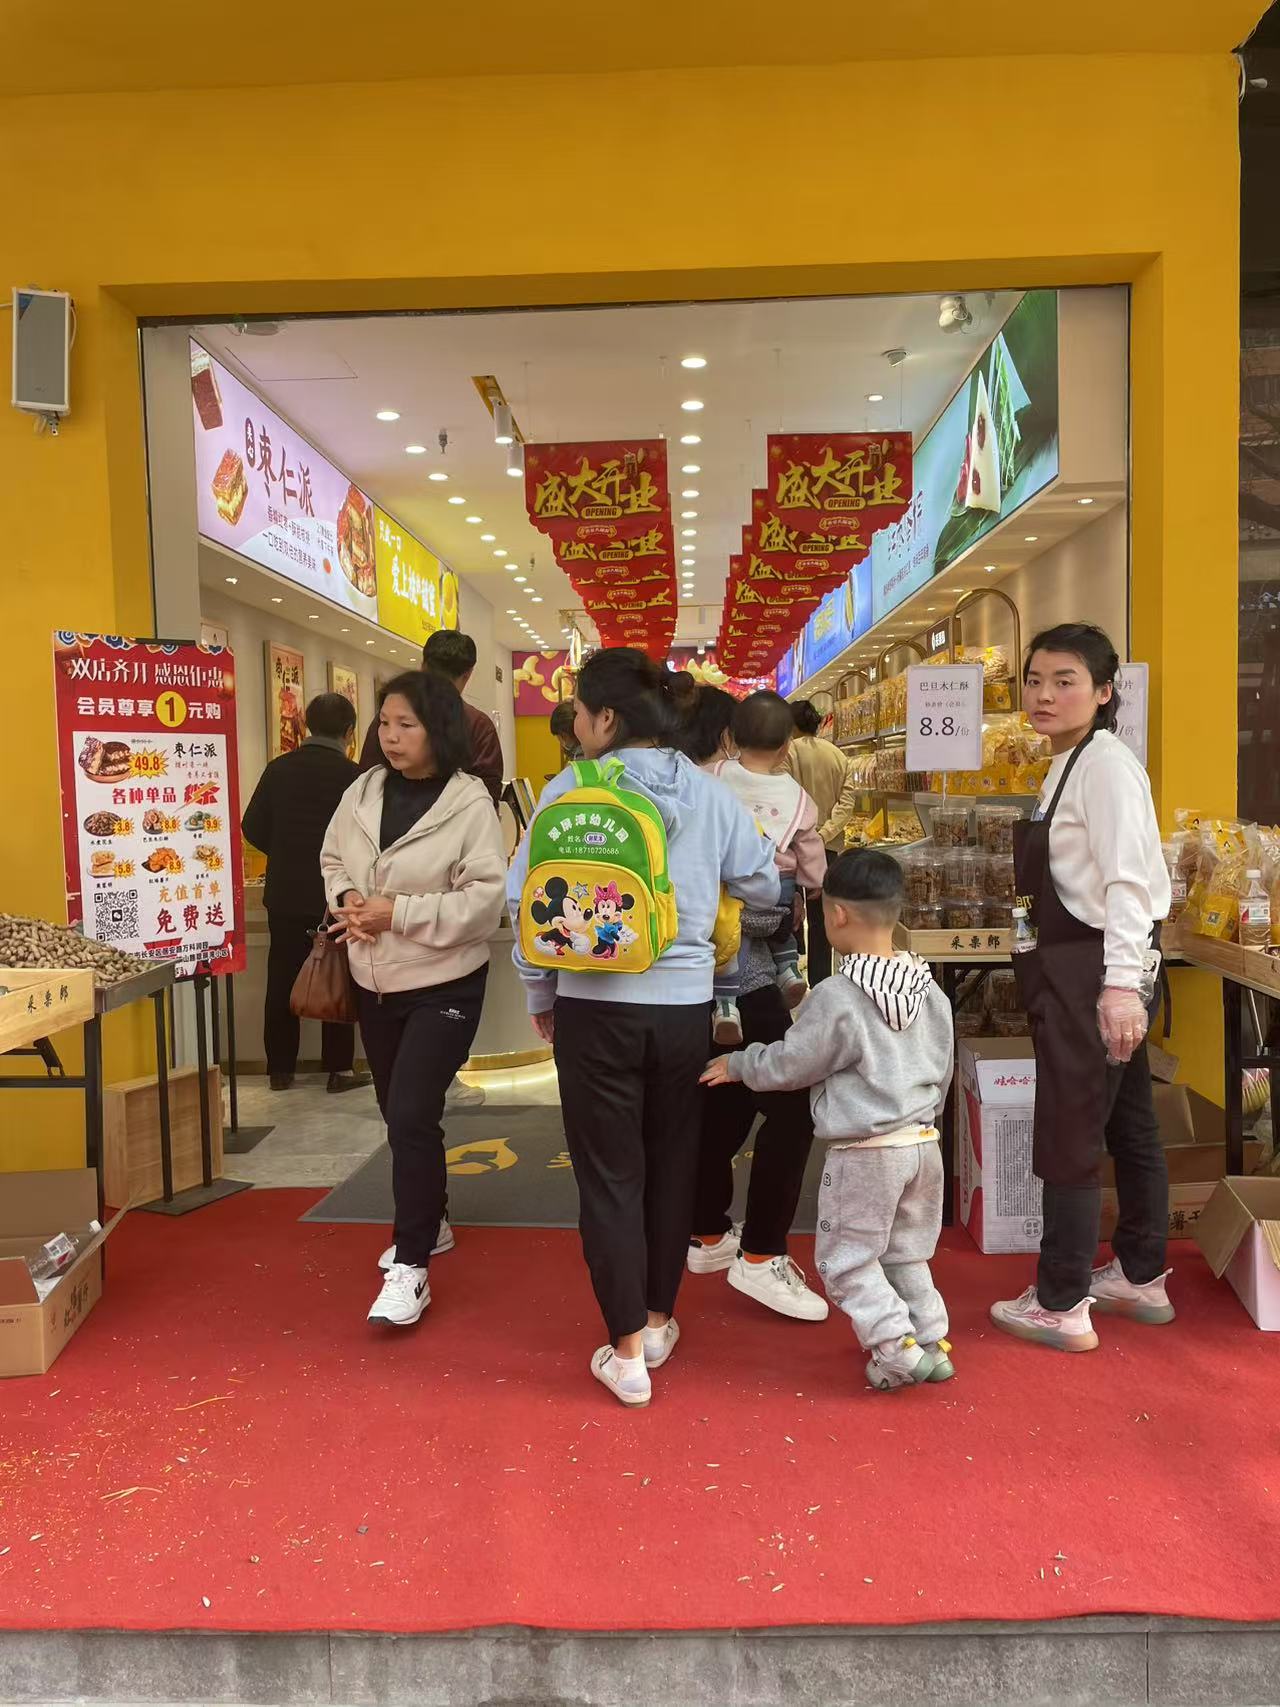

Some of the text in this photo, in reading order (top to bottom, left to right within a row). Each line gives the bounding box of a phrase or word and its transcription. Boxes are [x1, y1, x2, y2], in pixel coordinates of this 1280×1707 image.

[257, 424, 315, 518] 枣仁派
[775, 447, 906, 510] 盛大开业
[534, 456, 662, 519] 盛大开业
[828, 499, 861, 508] OPENING
[585, 506, 618, 518] OPENING
[602, 549, 629, 559] OPENING
[802, 544, 830, 553] OPENING
[71, 657, 147, 685] 双店齐开
[919, 681, 969, 692] 巴旦木仁酥
[173, 741, 218, 759] 枣仁派
[134, 756, 161, 771] 49.8
[112, 786, 177, 805] 各种单品
[117, 822, 130, 832] 3.8
[206, 820, 218, 829] 9.9
[118, 864, 131, 874] 5.8
[160, 880, 221, 903] 充值首单
[156, 902, 226, 935] 免费送
[951, 934, 1001, 950] 采栗郎
[994, 1075, 1036, 1087] 娃哈哈
[1168, 1209, 1201, 1232] 薯干
